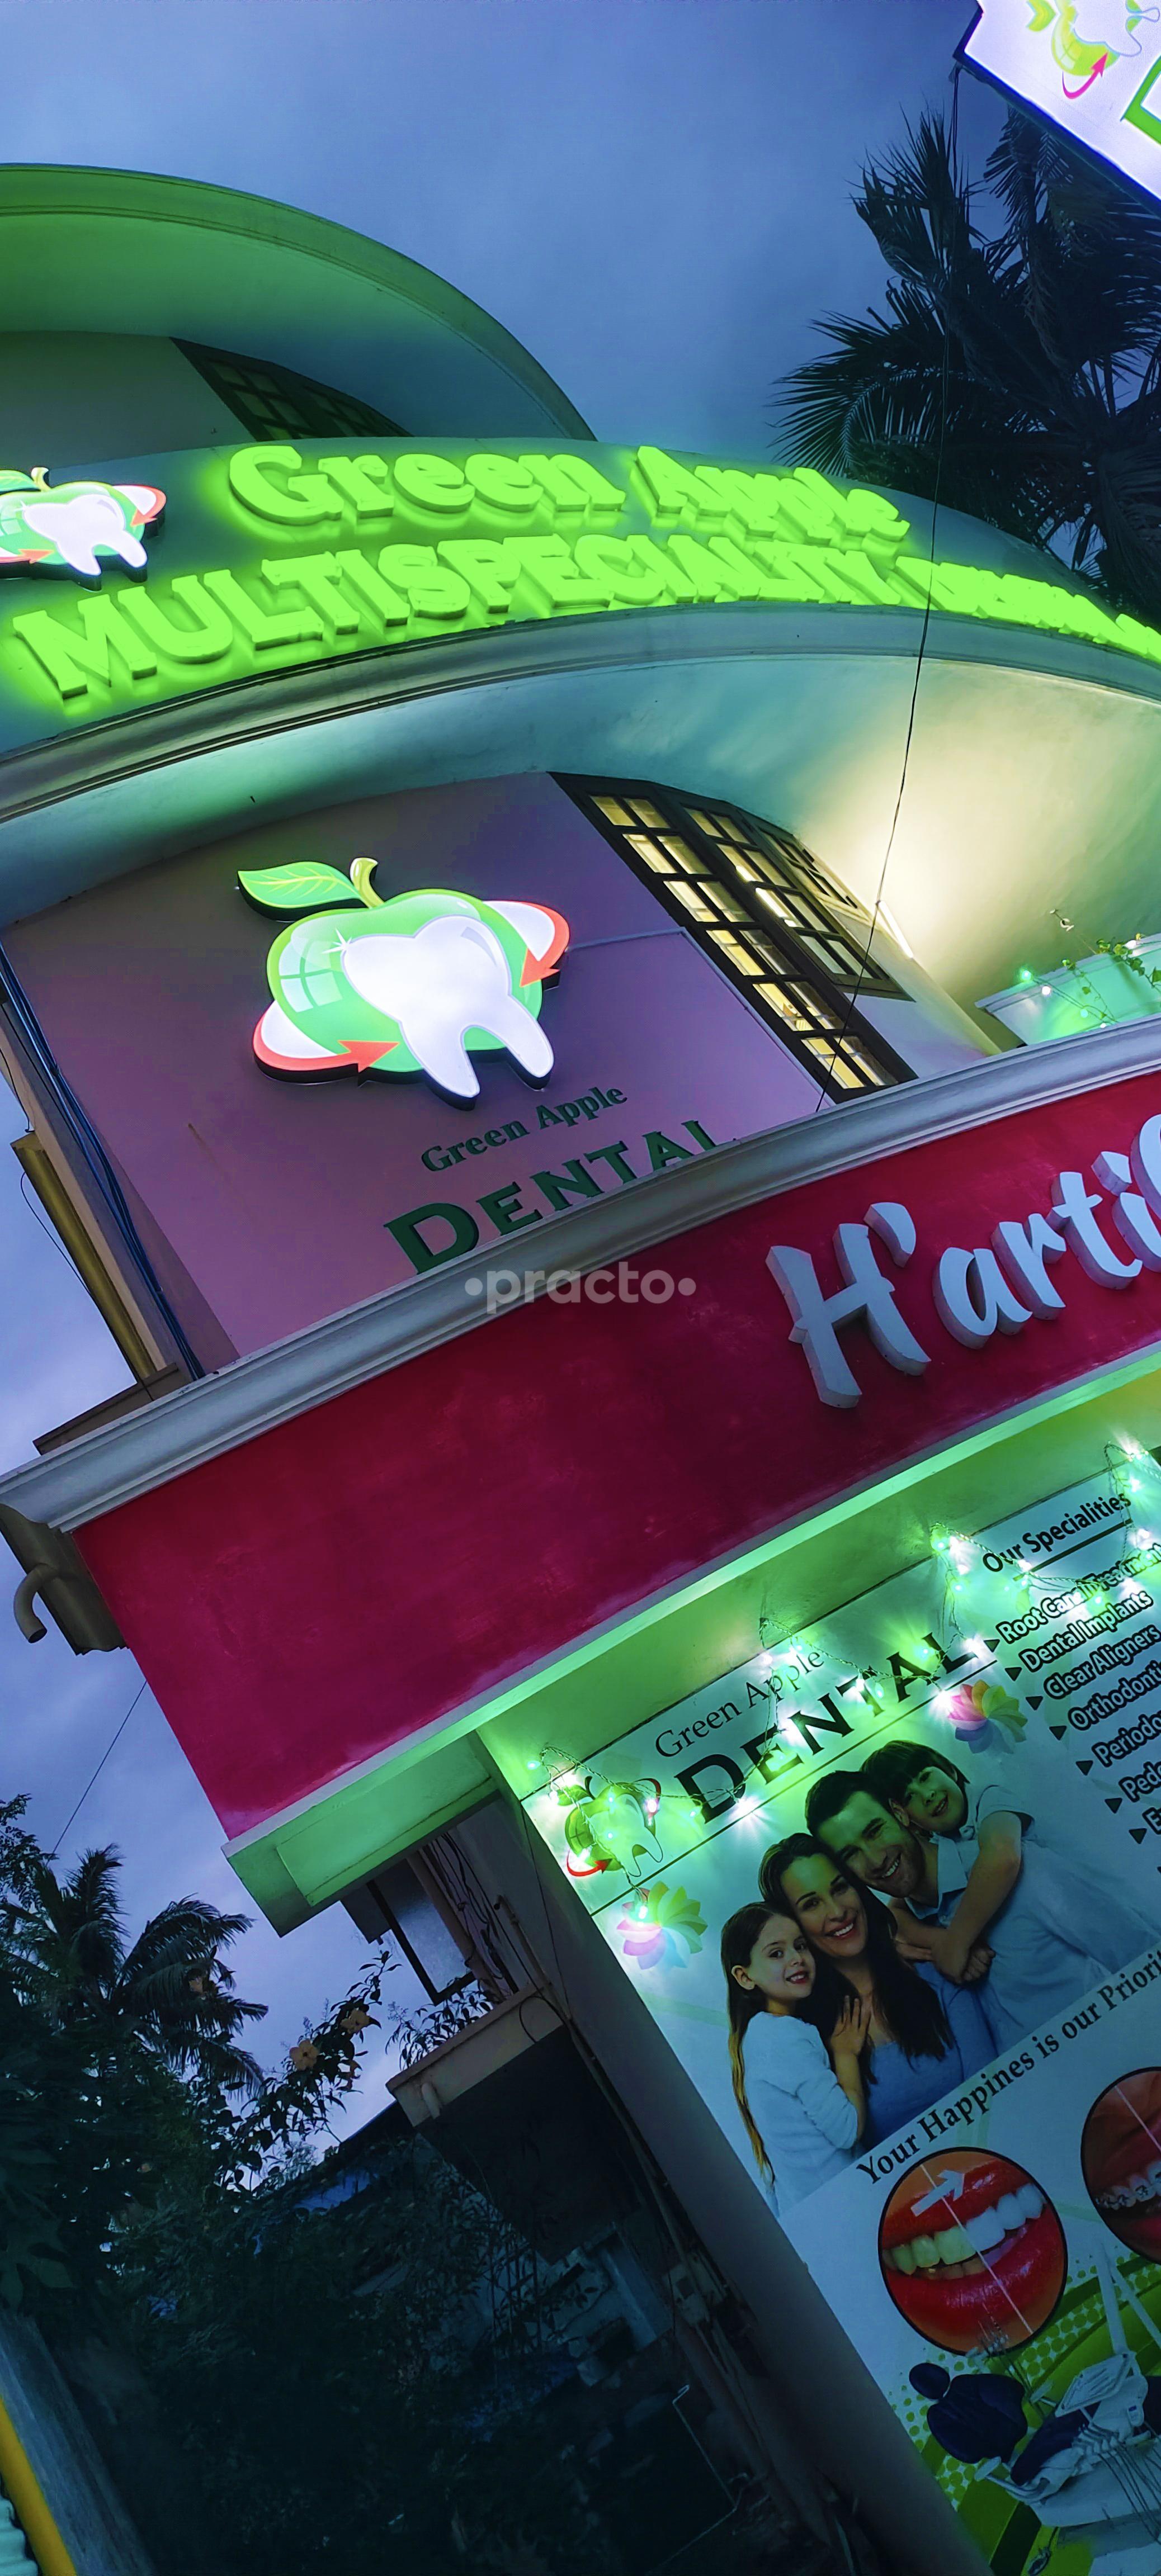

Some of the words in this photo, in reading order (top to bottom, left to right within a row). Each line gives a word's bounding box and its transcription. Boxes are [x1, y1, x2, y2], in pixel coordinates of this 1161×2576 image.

[229, 445, 626, 525] Green
[637, 446, 910, 540] Apple
[13, 534, 902, 699] MULTISPECIALITY
[421, 1120, 530, 1172] Green
[535, 1086, 628, 1129] Apple
[766, 1114, 1161, 1409] H'arti
[983, 1542, 1025, 1573] Our
[1022, 1493, 1131, 1552] Specialities
[996, 1607, 1047, 1645] Root
[1018, 1622, 1087, 1672] Dental
[1078, 1590, 1154, 1639] Implants
[1044, 1660, 1096, 1699] Clear
[1090, 1624, 1161, 1675] Aligners
[655, 1702, 743, 1757] Green
[745, 1651, 824, 1709] Apple
[674, 1632, 978, 1824] DENTAL
[856, 2134, 921, 2184] Your
[917, 2050, 1036, 2143] Happines
[1031, 2030, 1060, 2059] is
[1061, 2002, 1102, 2040] our
[1097, 1950, 1161, 2011] Priori
